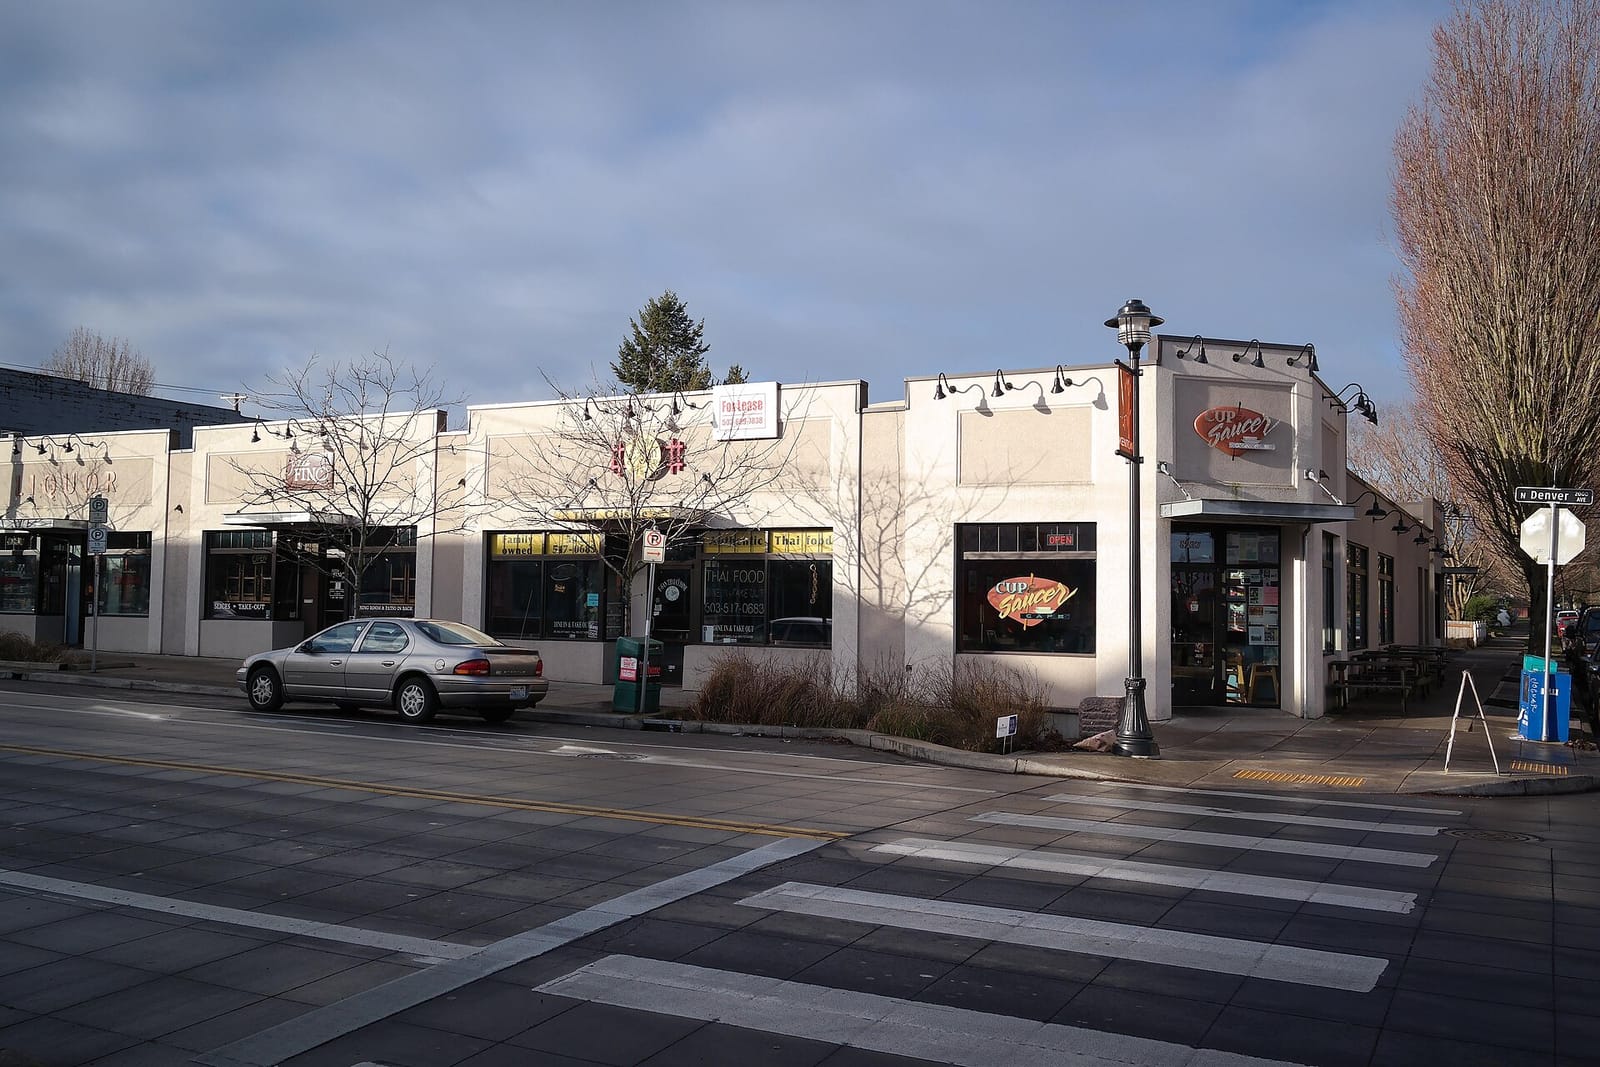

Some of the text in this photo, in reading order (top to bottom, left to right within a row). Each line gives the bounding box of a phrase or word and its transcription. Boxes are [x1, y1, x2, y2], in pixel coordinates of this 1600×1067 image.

[738, 399, 763, 412] Lease
[1205, 410, 1236, 423] CUP
[1208, 415, 1280, 448] Saucer
[17, 471, 117, 500] LIQUOR
[1531, 490, 1569, 501] Denver
[503, 534, 532, 544] Family
[774, 535, 800, 546] Thai
[806, 535, 832, 546] food
[1049, 535, 1072, 544] OPEN
[502, 545, 532, 554] owned
[706, 569, 765, 583] THAI FOOD
[995, 582, 1028, 594] CUP
[998, 582, 1079, 619] Saucer
